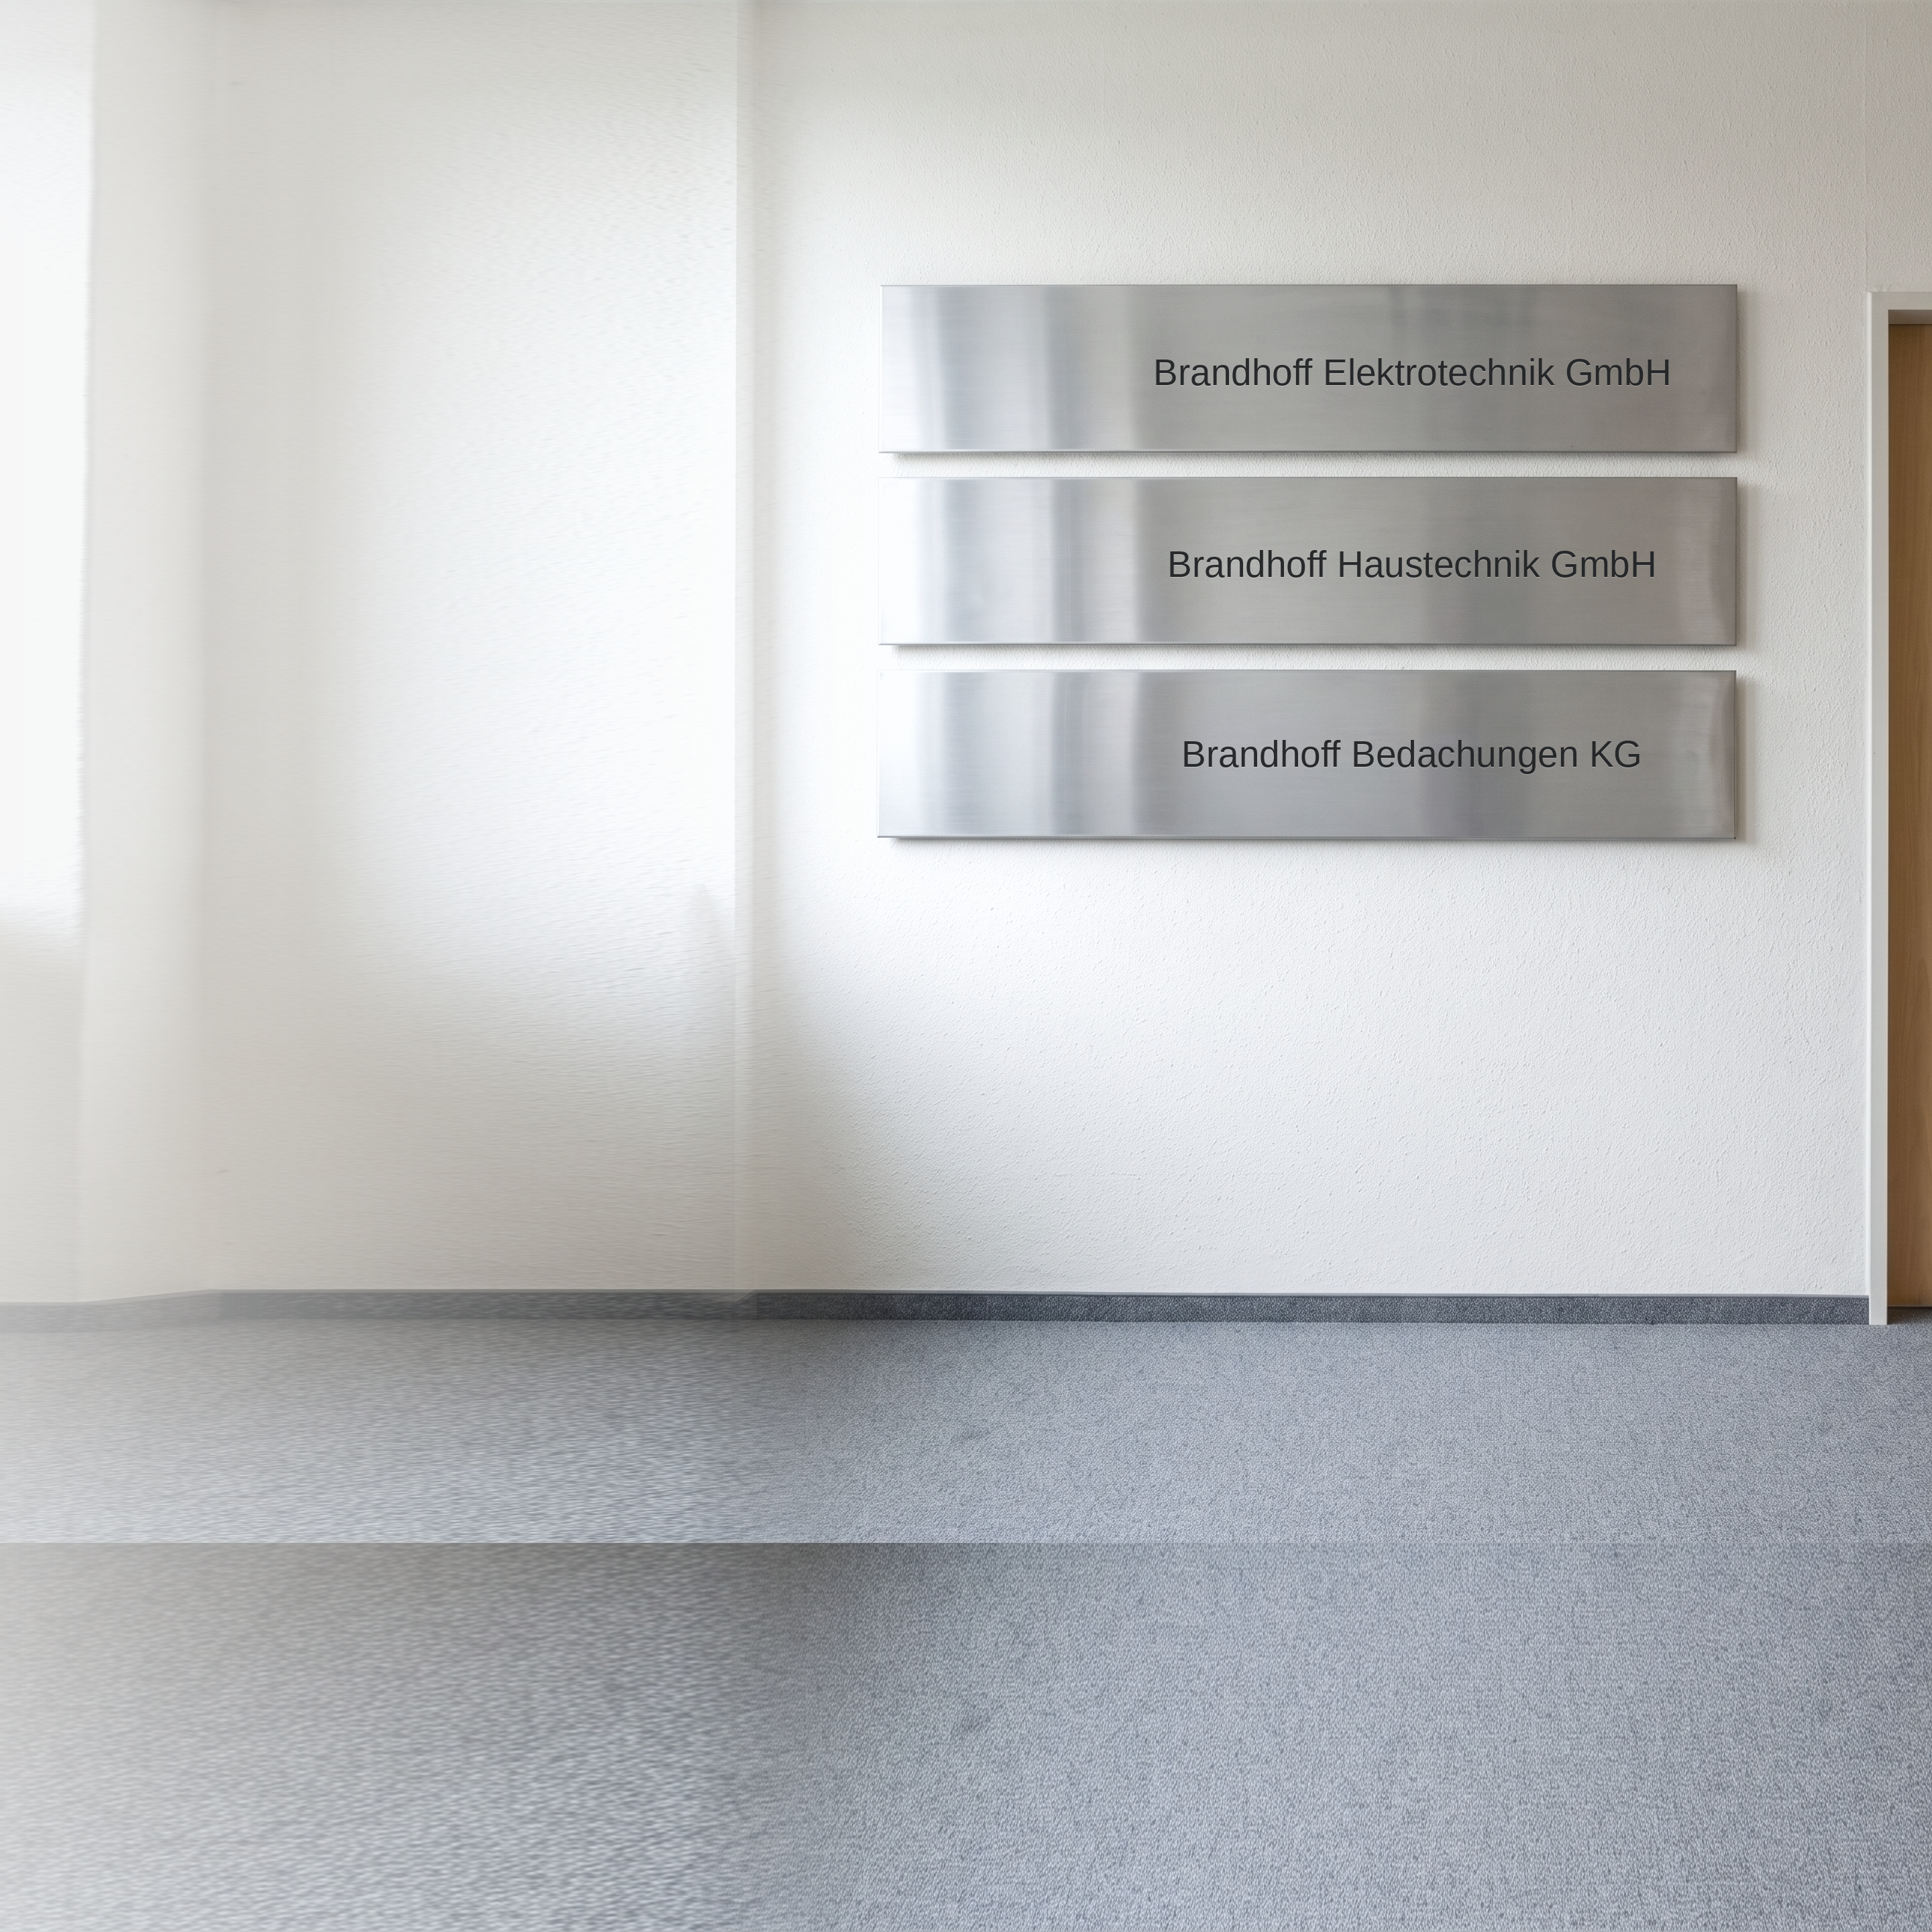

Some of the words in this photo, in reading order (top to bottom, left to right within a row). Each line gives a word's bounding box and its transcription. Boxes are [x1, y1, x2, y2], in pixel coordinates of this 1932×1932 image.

[1156, 358, 1312, 386] Brandhoff
[1326, 358, 1554, 386] Elektrotechnik
[1566, 358, 1669, 386] GmbH
[1170, 549, 1326, 578] Brandhoff
[1340, 549, 1540, 578] Haustechnik
[1552, 549, 1654, 578] GmbH
[1184, 739, 1340, 768] Brandhoff
[1354, 739, 1576, 775] Bedachungen
[1592, 739, 1640, 768] KG
